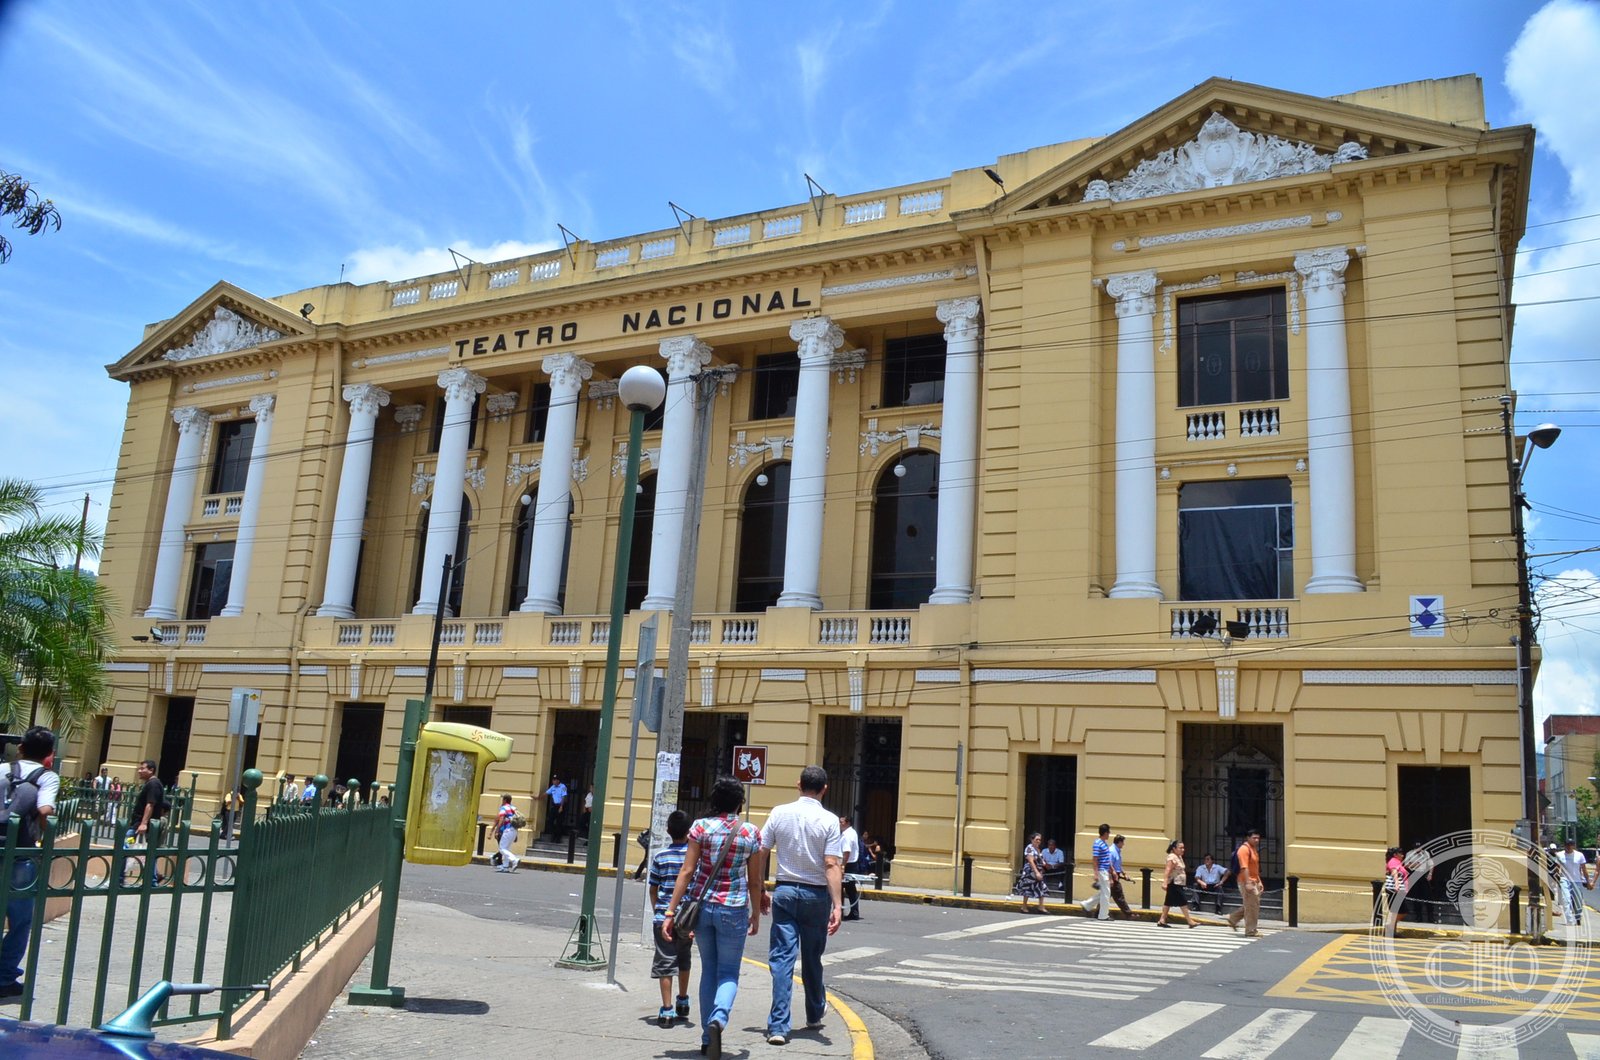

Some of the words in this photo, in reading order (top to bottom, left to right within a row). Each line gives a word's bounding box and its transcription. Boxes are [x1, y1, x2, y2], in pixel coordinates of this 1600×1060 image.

[455, 321, 578, 358] TEATRO
[621, 287, 812, 333] NACIONAL
[484, 734, 506, 742] telecom
